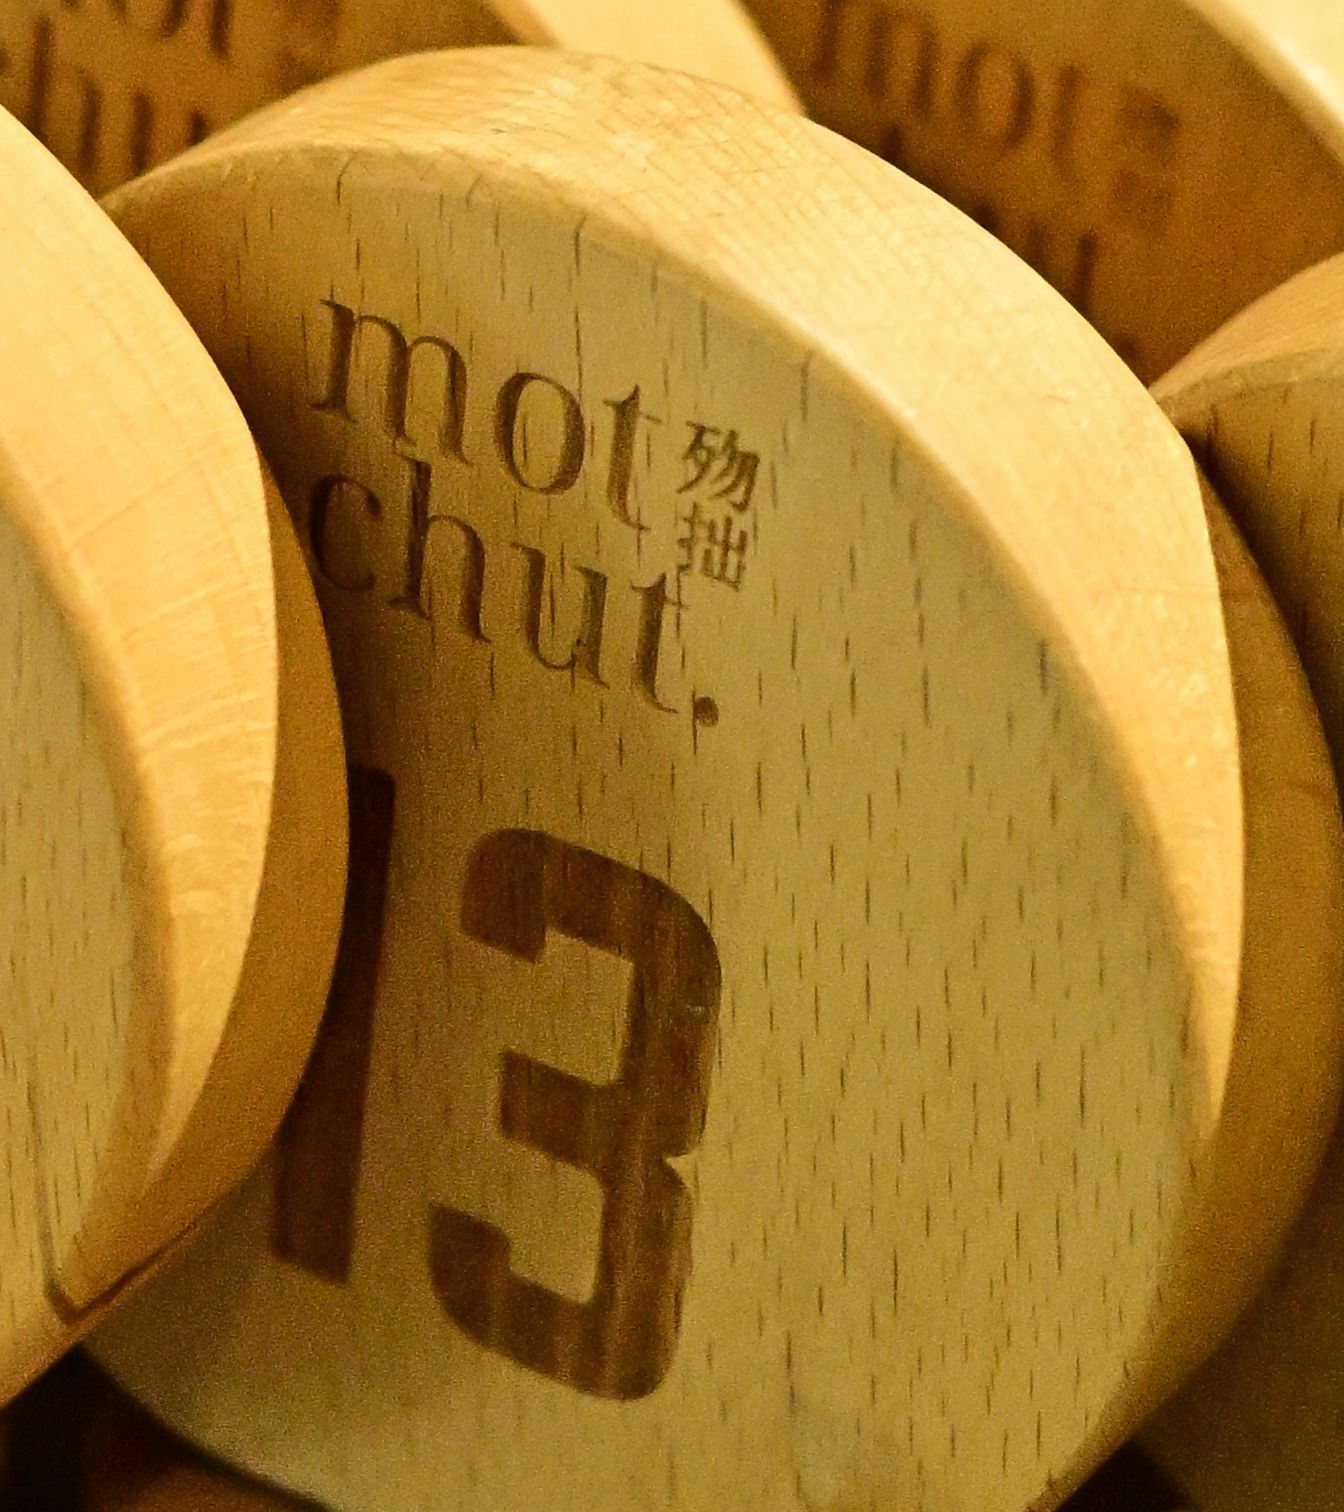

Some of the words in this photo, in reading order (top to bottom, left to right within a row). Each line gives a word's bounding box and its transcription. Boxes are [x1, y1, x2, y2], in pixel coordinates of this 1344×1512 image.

[313, 295, 664, 532] mot
[308, 438, 721, 729] chut.
[270, 769, 722, 1402] 13
